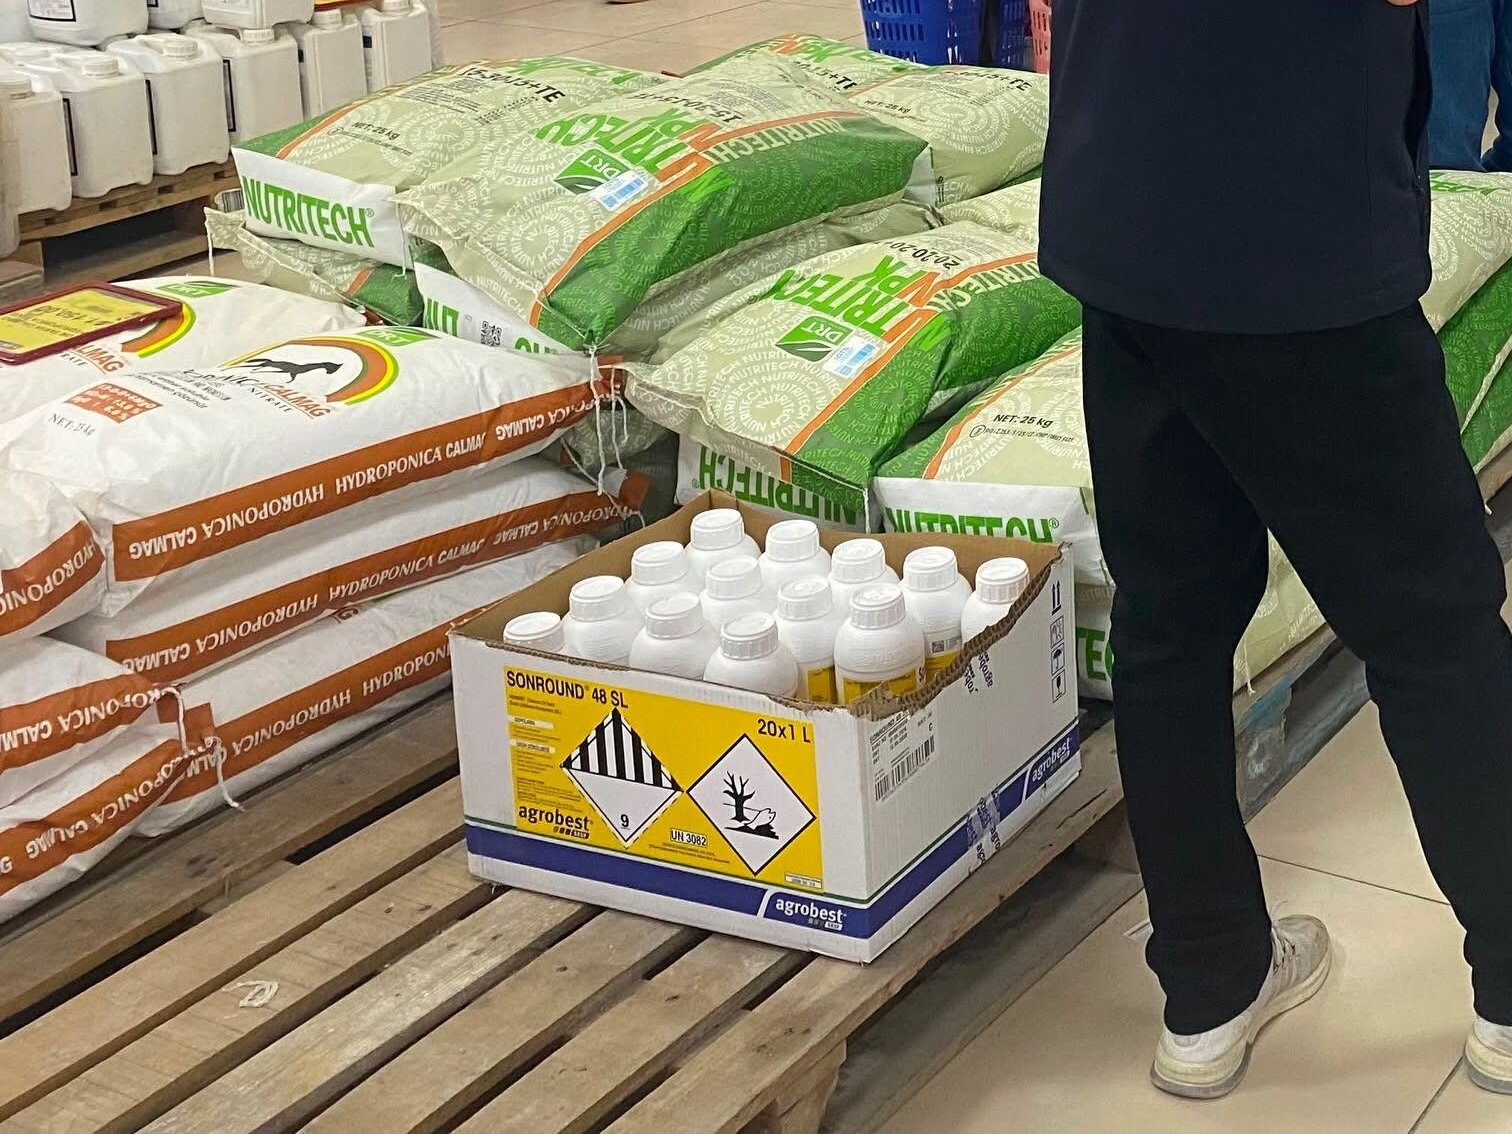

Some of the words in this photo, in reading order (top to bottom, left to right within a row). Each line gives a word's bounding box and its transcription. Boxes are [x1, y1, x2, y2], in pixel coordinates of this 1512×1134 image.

[241, 175, 375, 248] NUTRITECH
[993, 413, 1018, 424] NET:
[1019, 415, 1036, 426] 25
[1036, 417, 1054, 429] kg
[336, 446, 443, 496] HYDROPONICA
[201, 483, 326, 539] HYDROPONICA
[128, 526, 198, 561] CALMAG
[328, 554, 434, 602] HYDROPONICA
[194, 594, 320, 654] HYDROPONICA
[362, 642, 451, 698] HYDROPONI
[507, 669, 585, 700] SONROUND
[591, 687, 608, 705] 48
[610, 689, 629, 709] SL
[232, 687, 352, 758] HYDROPONICA
[757, 717, 796, 741] 20x1
[802, 726, 812, 744] L
[1031, 737, 1071, 782] agrobest
[518, 804, 590, 832] agrobest
[620, 813, 630, 828] 9
[671, 829, 685, 842] UN
[686, 832, 707, 847] 3082
[775, 896, 844, 923] agrobest
